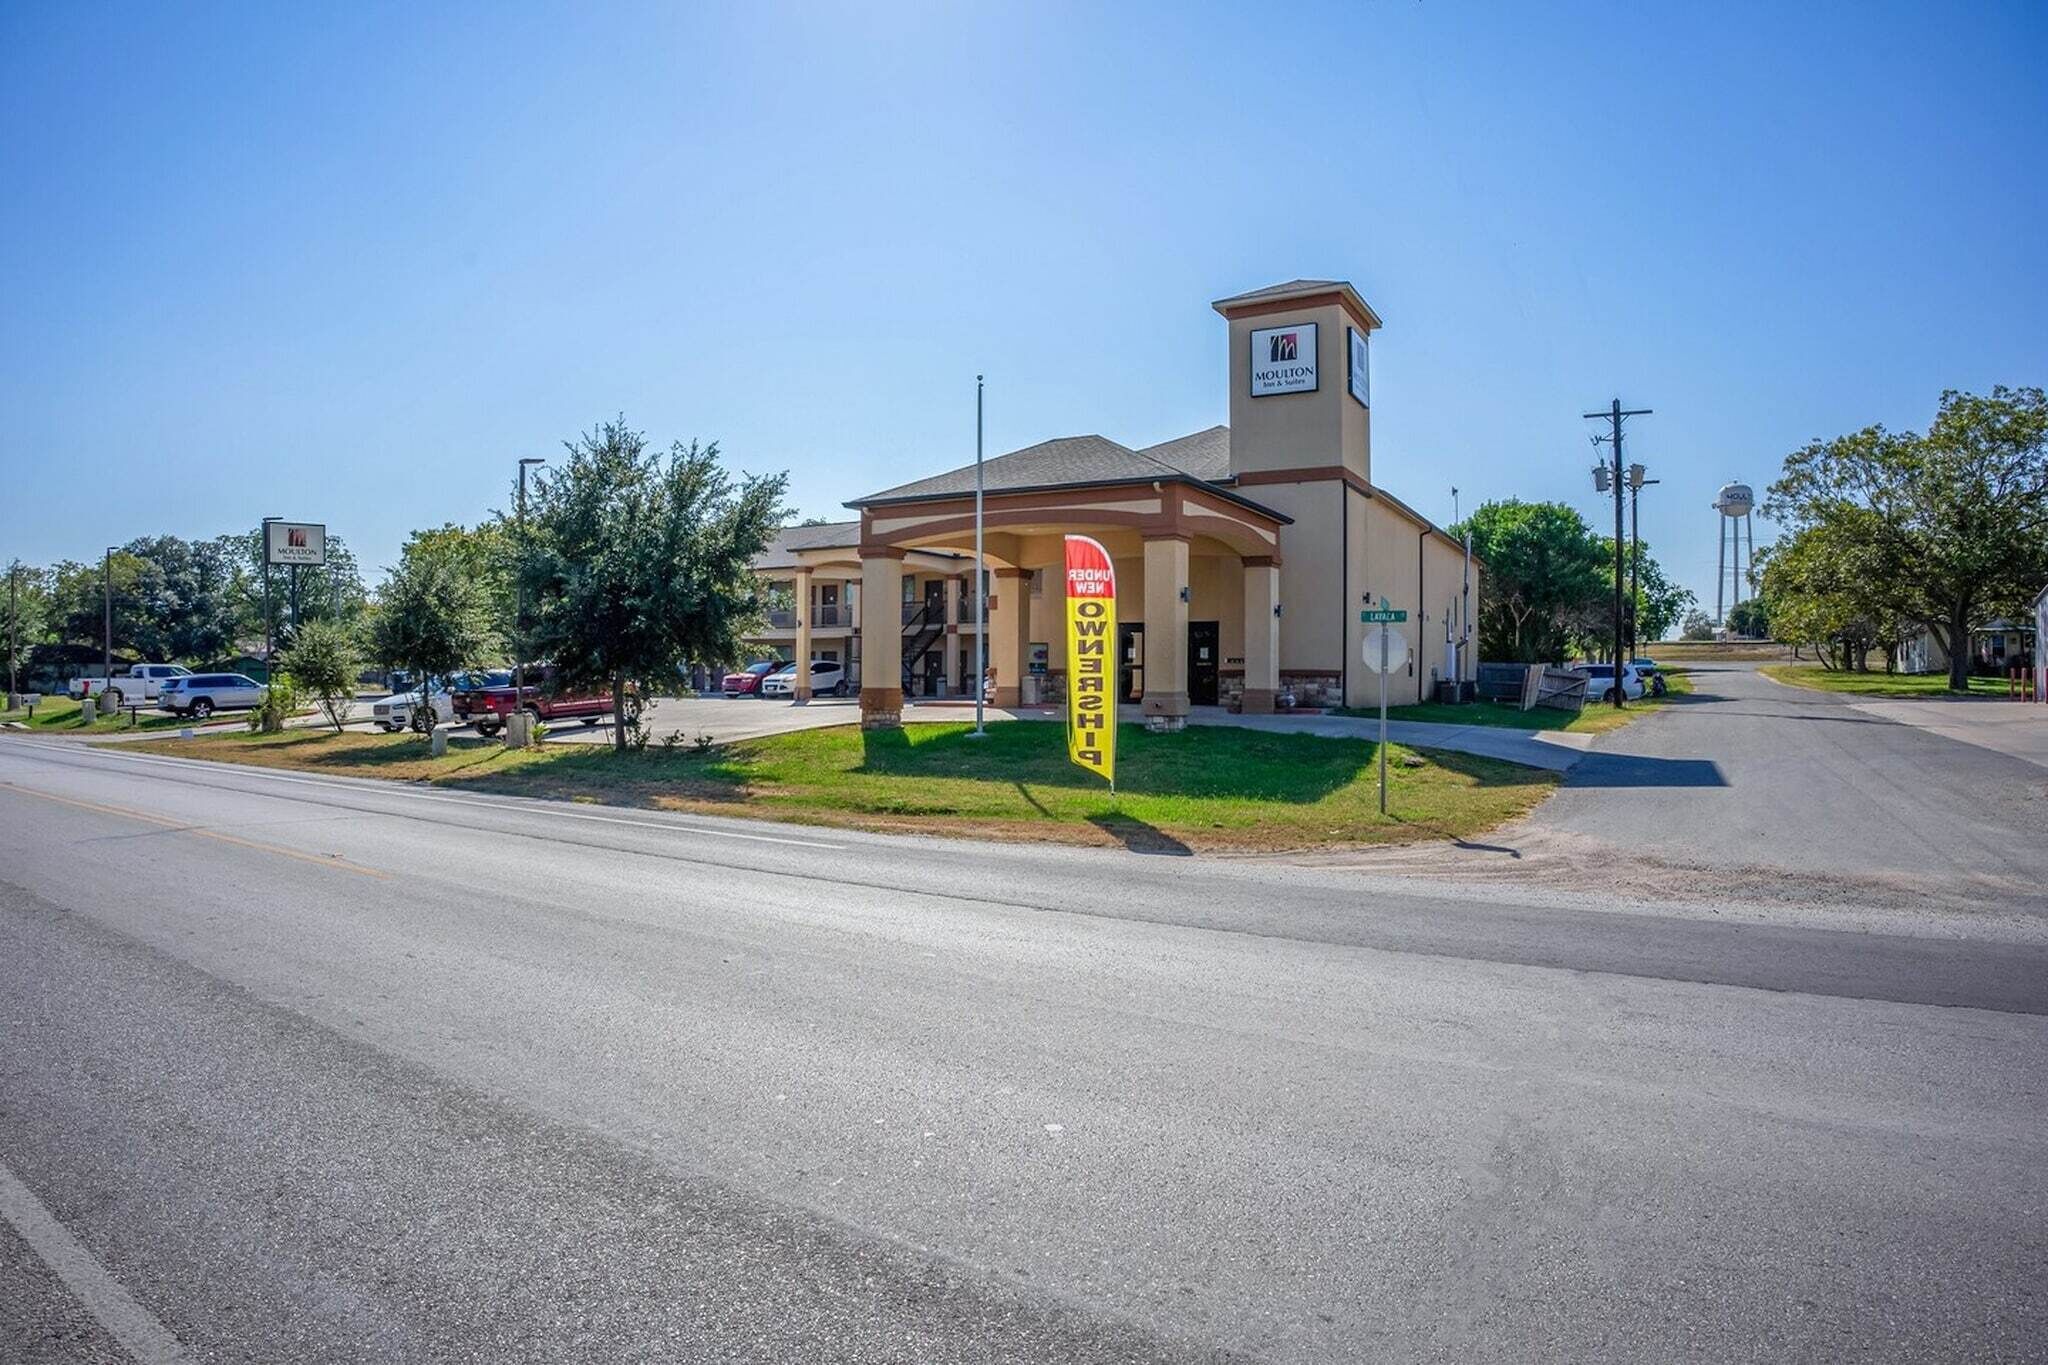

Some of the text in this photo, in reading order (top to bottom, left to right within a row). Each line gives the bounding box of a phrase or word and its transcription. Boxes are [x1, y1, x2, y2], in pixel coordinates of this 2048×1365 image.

[1255, 366, 1314, 382] MOULTON
[1263, 381, 1276, 389] Inn
[1285, 378, 1306, 387] Suites
[278, 548, 317, 556] MOULTON
[1371, 612, 1396, 621] LAVACA
